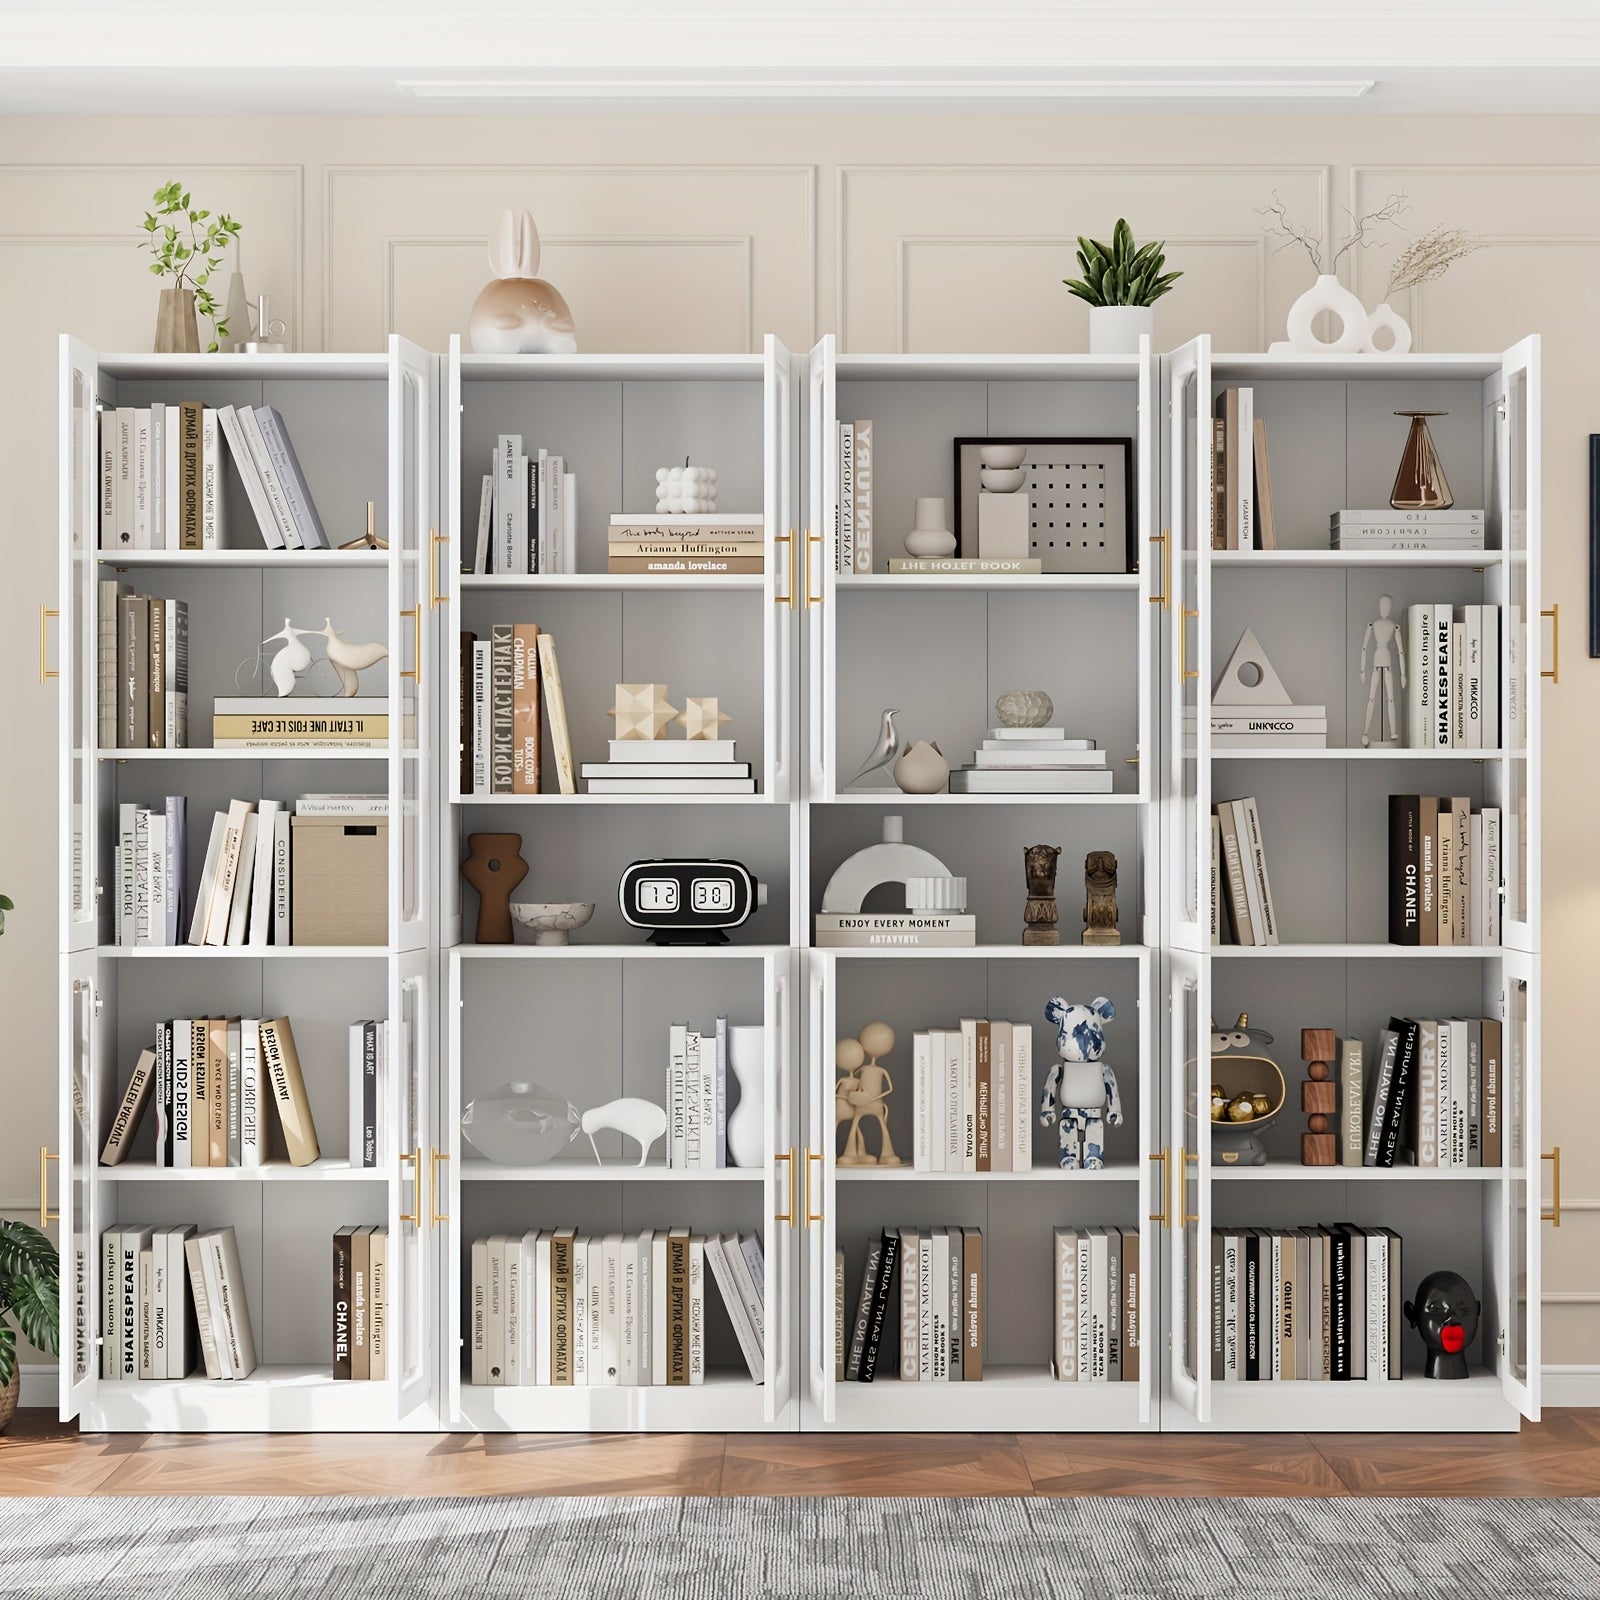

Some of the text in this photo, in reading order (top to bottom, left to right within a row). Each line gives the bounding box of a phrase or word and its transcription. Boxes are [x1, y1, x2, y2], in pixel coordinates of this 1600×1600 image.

[184, 407, 198, 439] ДУМАЙ
[184, 443, 198, 451] В
[184, 452, 198, 487] ДРУГИХ
[184, 490, 198, 538] ФОРМАТАХ
[643, 526, 664, 537] body
[668, 528, 700, 541] beyond
[637, 544, 737, 555] Arianna Huffington
[647, 561, 728, 570] amanda lovelace
[513, 637, 525, 690] CHAPMAN
[527, 647, 536, 679] CALLUM
[1421, 614, 1430, 706] Rooms to Inspire
[1439, 621, 1448, 745] SHAKESPEARE
[1470, 678, 1478, 720] ПИКАССО
[251, 720, 364, 735] IL ÉTAIT UNE FOIS LE CAFÉ
[494, 632, 512, 785] БОРИС ПАСТЕРНАК
[513, 748, 524, 772] TUTS+
[525, 736, 535, 785] BOOK COVER
[1455, 810, 1469, 885] The body beyond
[277, 839, 286, 919] CONSIDERED
[653, 886, 721, 904] 12 30
[1424, 835, 1434, 912] amanda lovelace
[1440, 836, 1451, 924] Arianna Huffington
[839, 919, 951, 928] ENJOY EVERY MOMENT
[365, 1031, 374, 1053] WHAT
[365, 1060, 374, 1076] ART
[1018, 1044, 1027, 1153] НОВЫЙ ОБРАЗ ЖИЗНИ
[1421, 1028, 1435, 1163] CENTURY
[365, 1126, 374, 1162] Leo Tolstoy
[965, 1114, 973, 1158] ШОКОЛАД
[1469, 1124, 1478, 1150] FLAKE
[555, 1242, 569, 1275] ДУМАЙ
[671, 1242, 685, 1275] ДУМАЙ
[107, 1243, 116, 1336] Rooms to Inspire
[355, 1271, 366, 1346] amanda lovelace
[372, 1262, 383, 1355] Arianna Huffington
[555, 1286, 567, 1322] ДРУГИХ
[671, 1286, 683, 1322] ДРУГИХ
[903, 1242, 917, 1377] CENTURY
[921, 1244, 929, 1373] MARILYN MONROE
[1061, 1242, 1076, 1377] CENTURY
[1080, 1244, 1088, 1373] MARILYN MONROE
[125, 1250, 134, 1375] SHAKESPEARE
[156, 1307, 164, 1349] ПИКАССО
[556, 1324, 567, 1373] ФОРМАТАХ
[672, 1324, 683, 1373] ФОРМАТАХ
[950, 1337, 960, 1364] FLAKE
[1109, 1337, 1118, 1364] FLAKE
